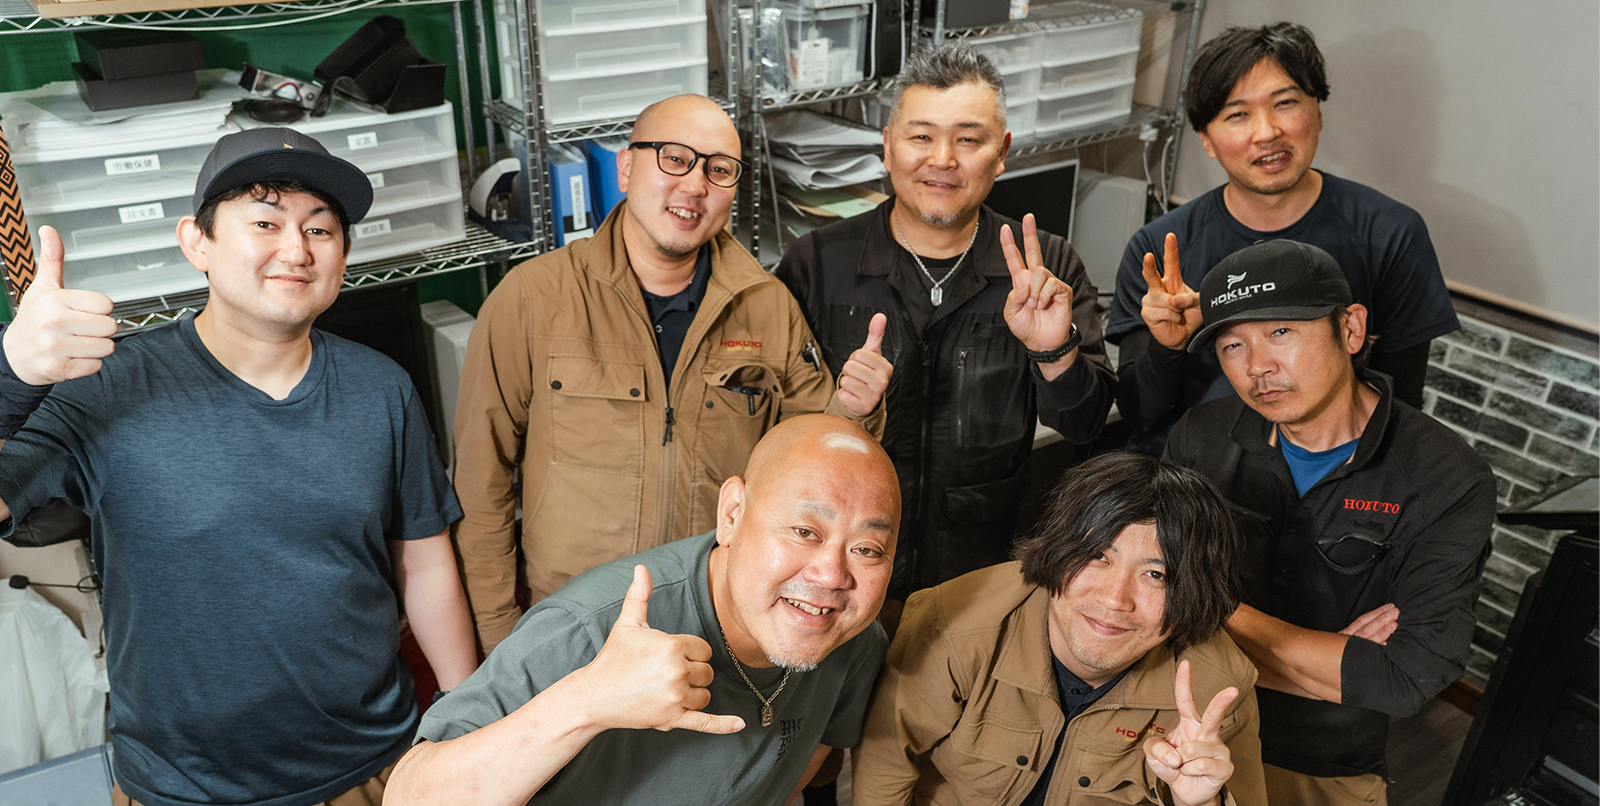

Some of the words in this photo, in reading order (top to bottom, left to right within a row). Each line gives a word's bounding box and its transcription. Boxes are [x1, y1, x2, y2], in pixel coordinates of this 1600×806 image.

[127, 207, 157, 220] 注文書
[361, 222, 386, 236] 建設業
[1210, 282, 1276, 308] HOKUTO
